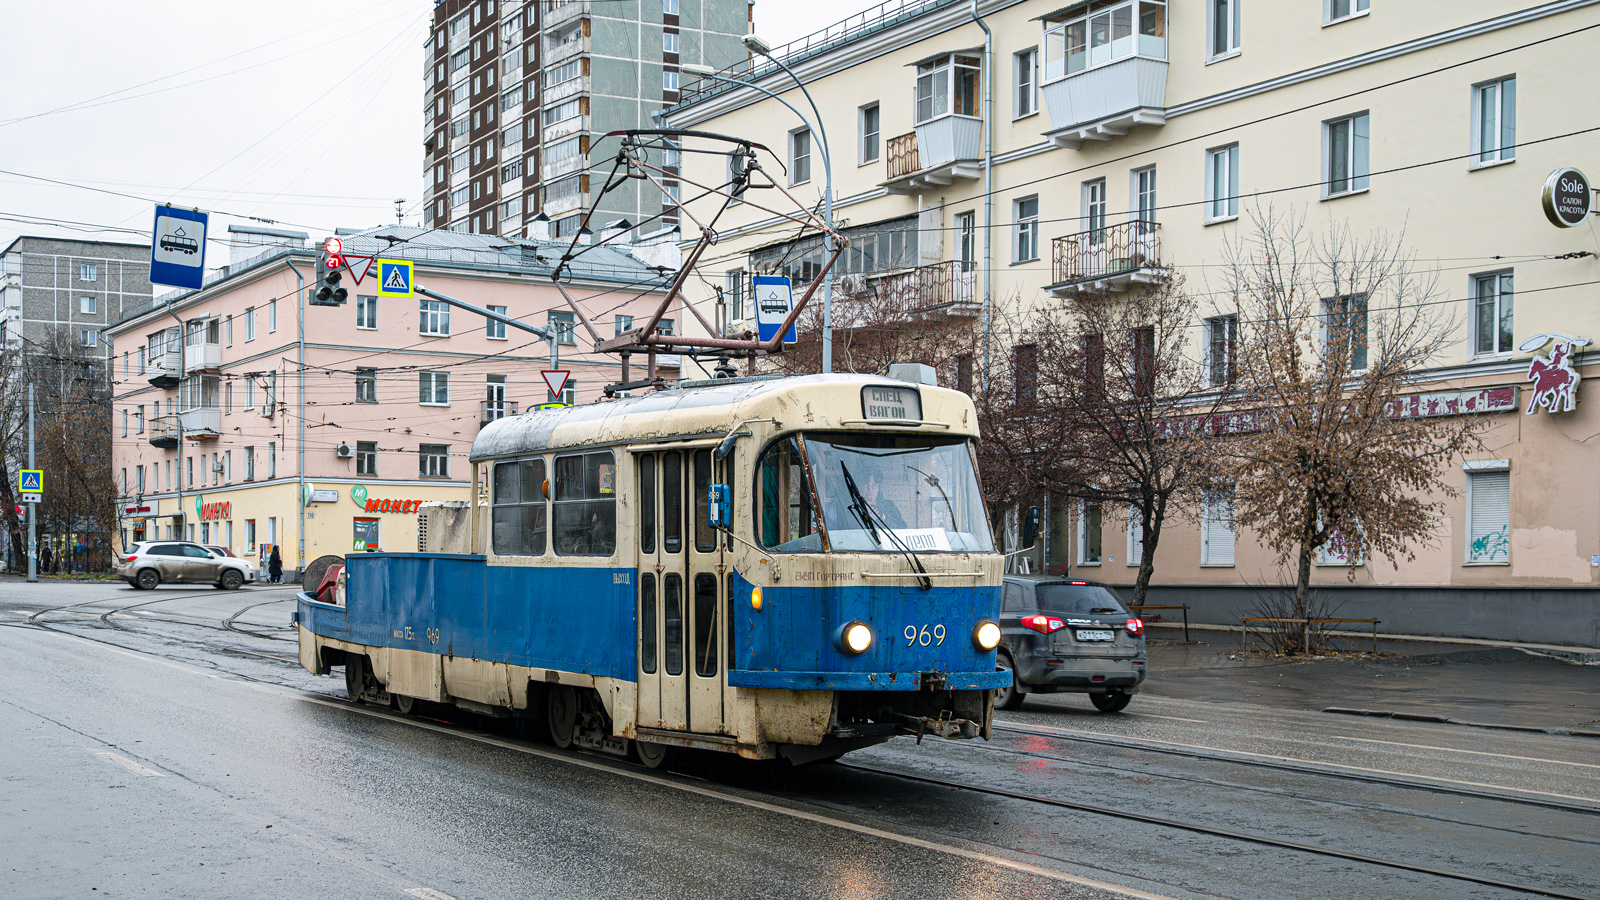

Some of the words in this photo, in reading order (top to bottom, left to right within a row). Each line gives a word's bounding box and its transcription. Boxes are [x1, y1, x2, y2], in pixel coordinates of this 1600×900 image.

[1561, 178, 1583, 193] Sole
[1562, 196, 1582, 205] САЛОН
[1559, 206, 1585, 214] КРАСОТЫ
[328, 257, 339, 267] 27
[871, 388, 903, 405] СПЕЦ
[869, 404, 906, 419] ВАГОН
[426, 627, 440, 644] 969
[904, 624, 947, 647] 969
